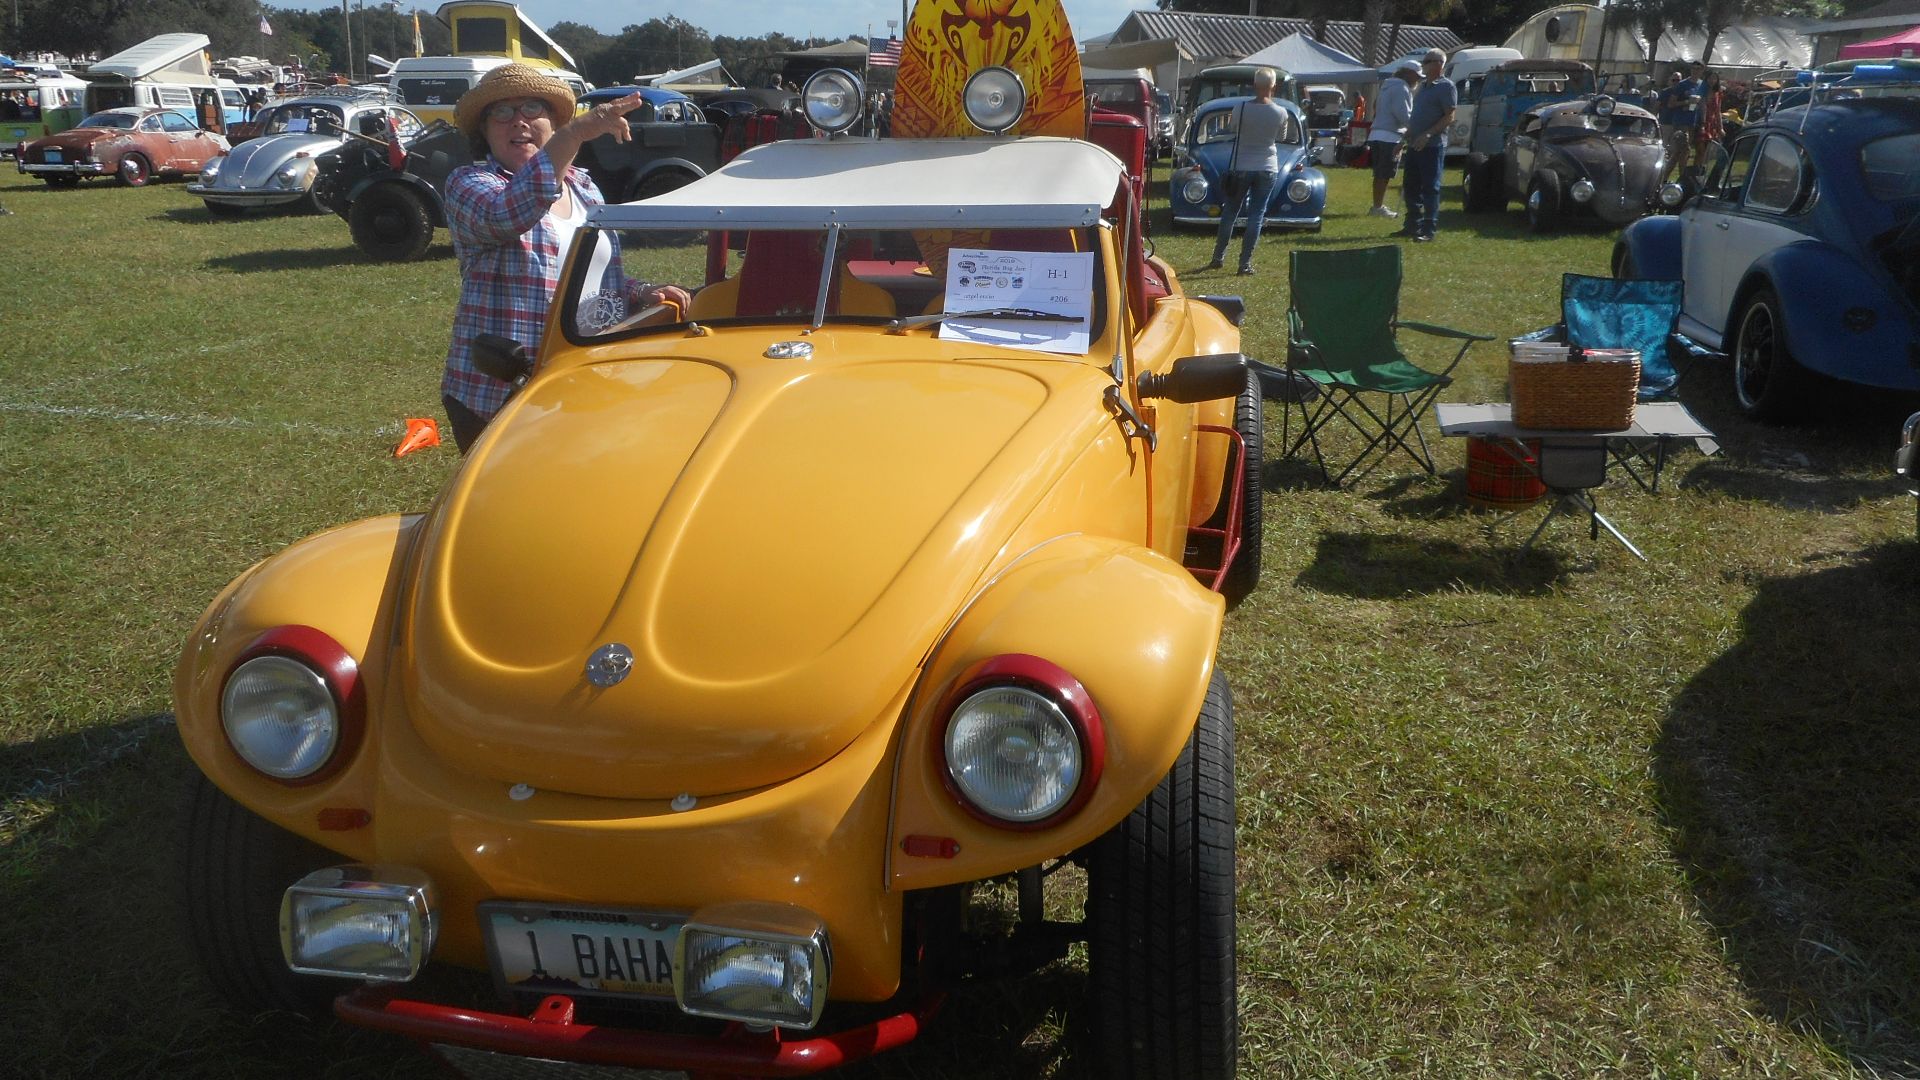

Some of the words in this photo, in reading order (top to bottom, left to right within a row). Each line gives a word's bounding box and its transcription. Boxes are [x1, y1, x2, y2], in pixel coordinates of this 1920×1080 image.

[1048, 269, 1067, 279] H-1
[526, 930, 548, 975] 1
[571, 933, 674, 984] BAHA
